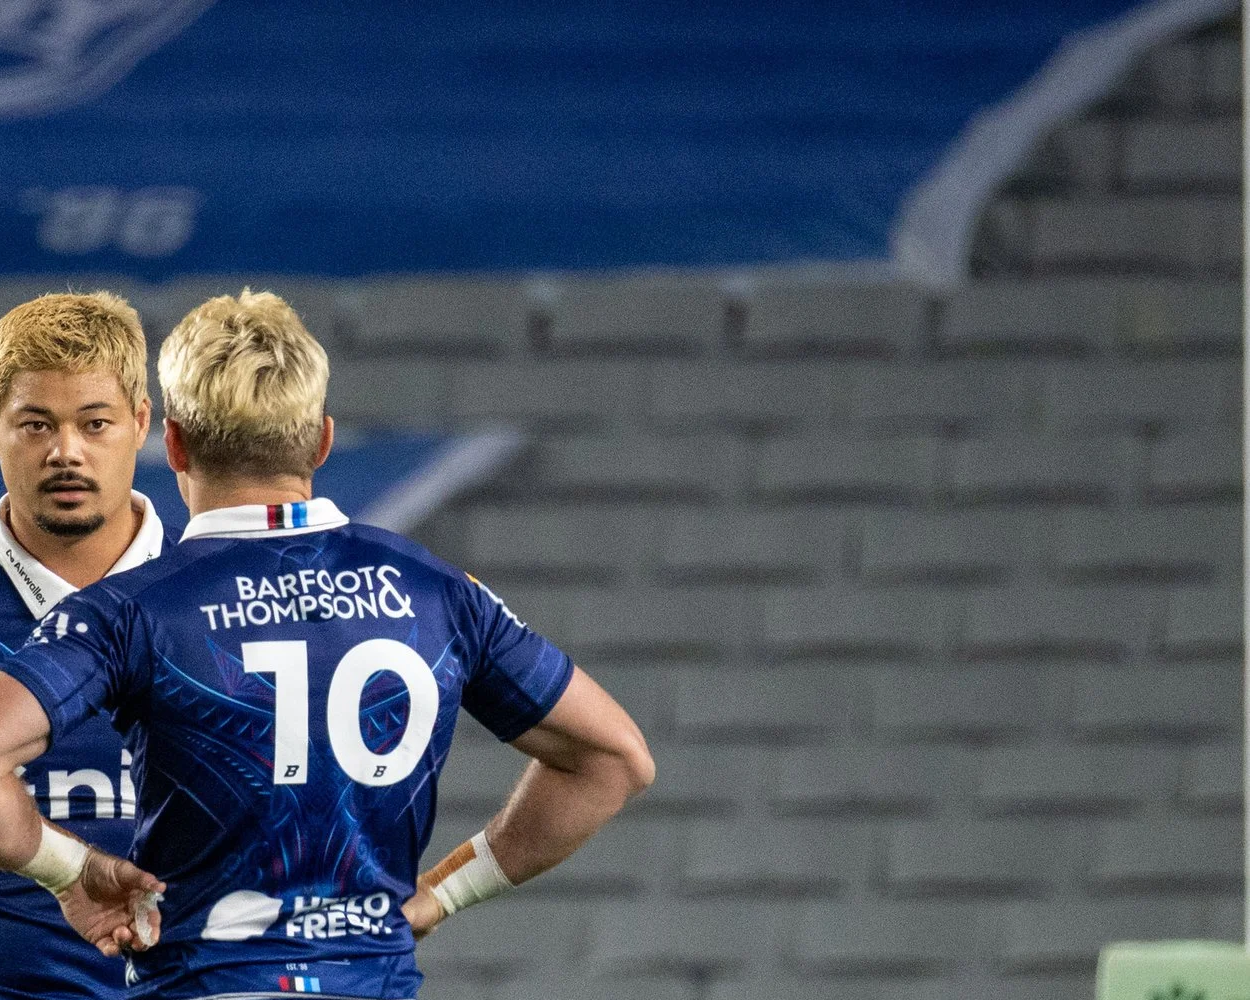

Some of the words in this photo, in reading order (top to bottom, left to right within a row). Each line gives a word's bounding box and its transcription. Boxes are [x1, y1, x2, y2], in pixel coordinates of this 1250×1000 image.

[14, 562, 46, 606] Airwallex
[236, 566, 376, 602] BARFOOT
[374, 565, 416, 619] &
[200, 594, 380, 631] THOMPSON
[241, 638, 440, 787] 10
